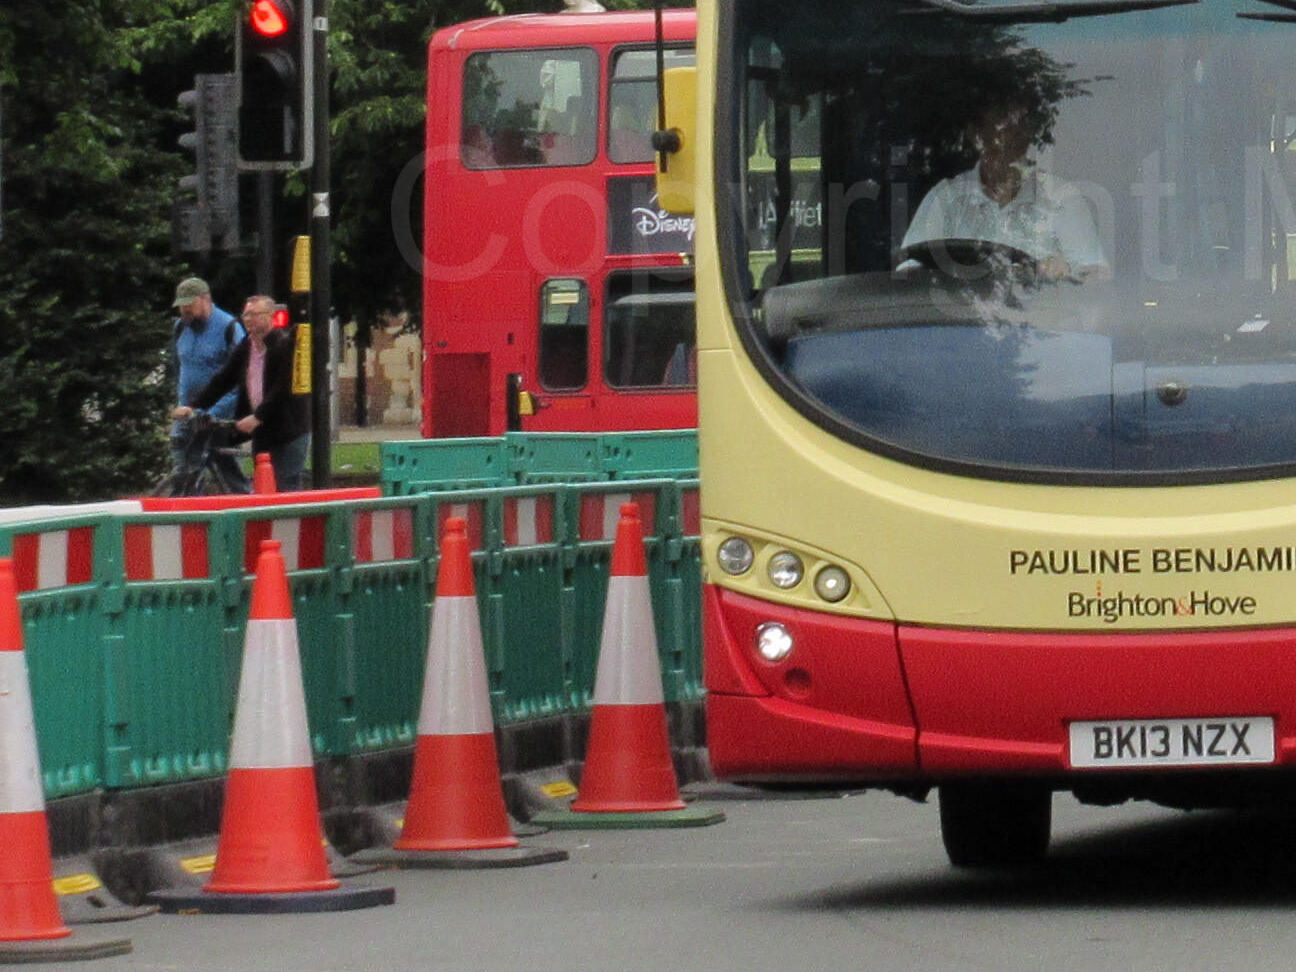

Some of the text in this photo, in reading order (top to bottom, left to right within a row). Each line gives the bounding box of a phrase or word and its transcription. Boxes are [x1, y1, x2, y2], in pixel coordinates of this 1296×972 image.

[1009, 549, 1141, 575] PAULINE
[1093, 722, 1251, 759] BK13 NZX
